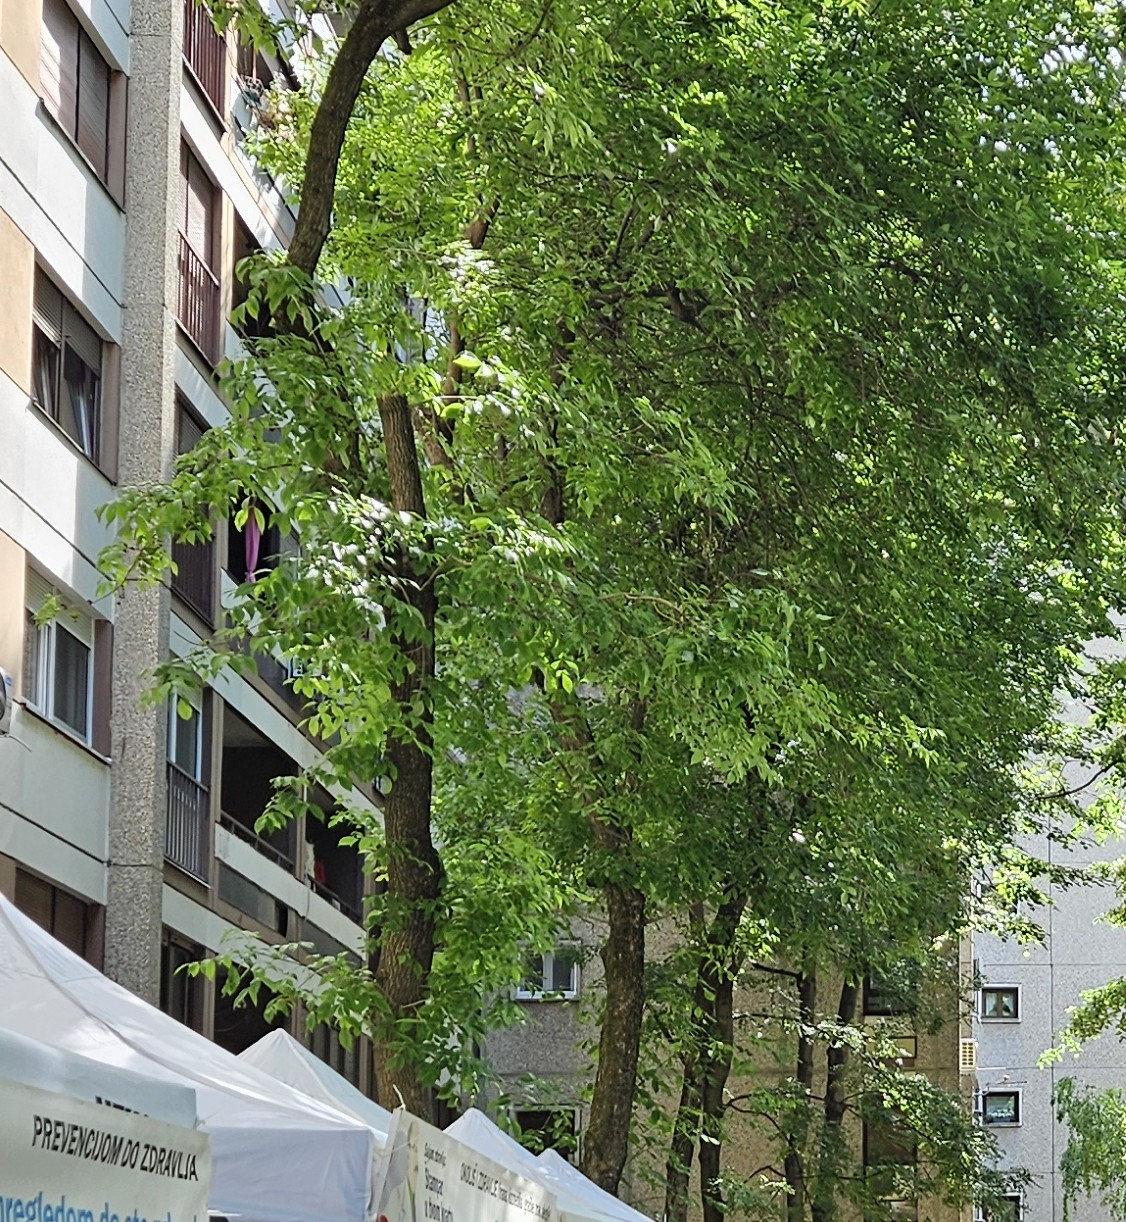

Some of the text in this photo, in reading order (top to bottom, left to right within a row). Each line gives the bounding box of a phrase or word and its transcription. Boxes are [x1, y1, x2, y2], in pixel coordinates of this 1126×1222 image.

[31, 1114, 199, 1182] PREVENCIJOM DO ZDRAVLJA
